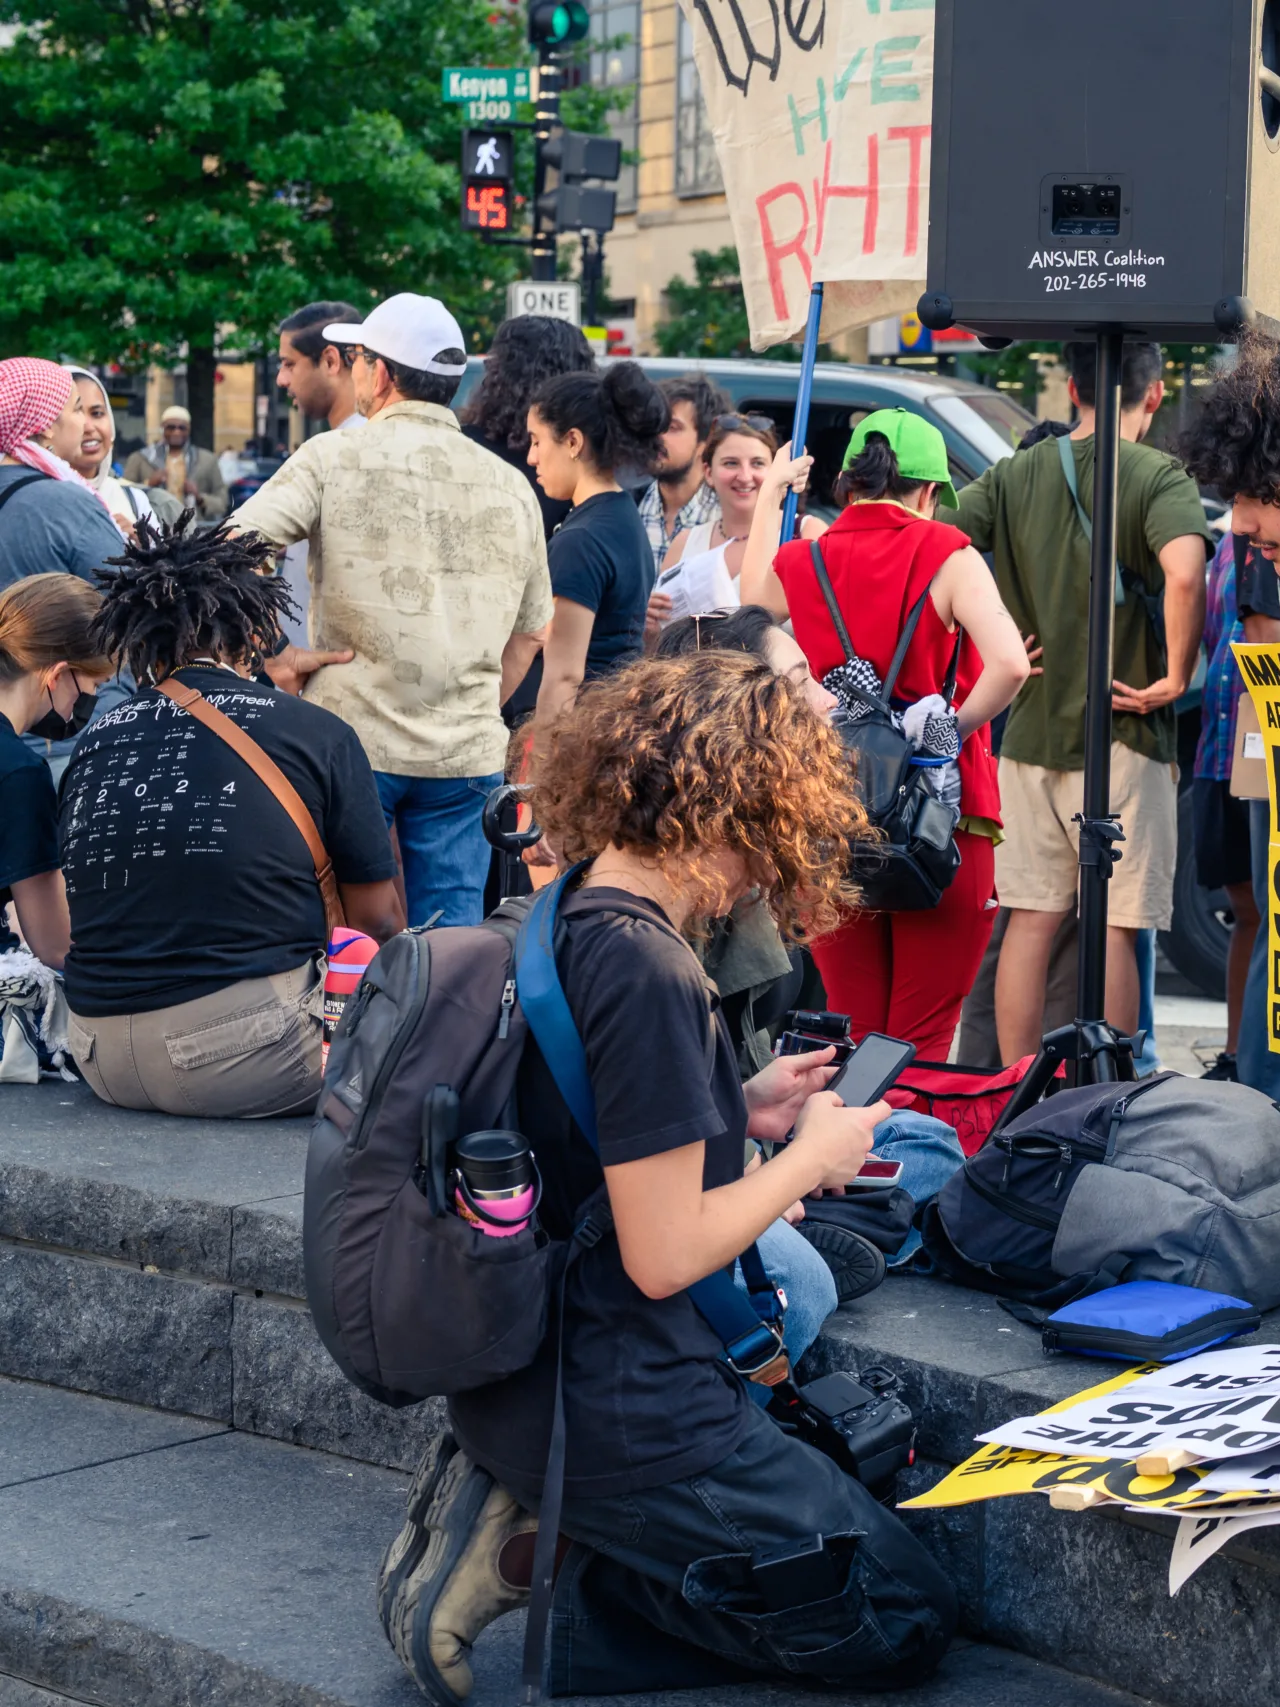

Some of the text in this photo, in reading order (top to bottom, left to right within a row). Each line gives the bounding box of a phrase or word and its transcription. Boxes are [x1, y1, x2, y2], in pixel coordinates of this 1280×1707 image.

[450, 72, 508, 101] Kenyon
[469, 101, 511, 120] 1300
[467, 186, 507, 228] 45
[1027, 249, 1165, 269] ANSWER Coalition
[1043, 272, 1147, 292] 202-265-1948
[523, 291, 570, 313] ONE
[231, 695, 276, 708] Freak
[1022, 1424, 1164, 1449] THE
